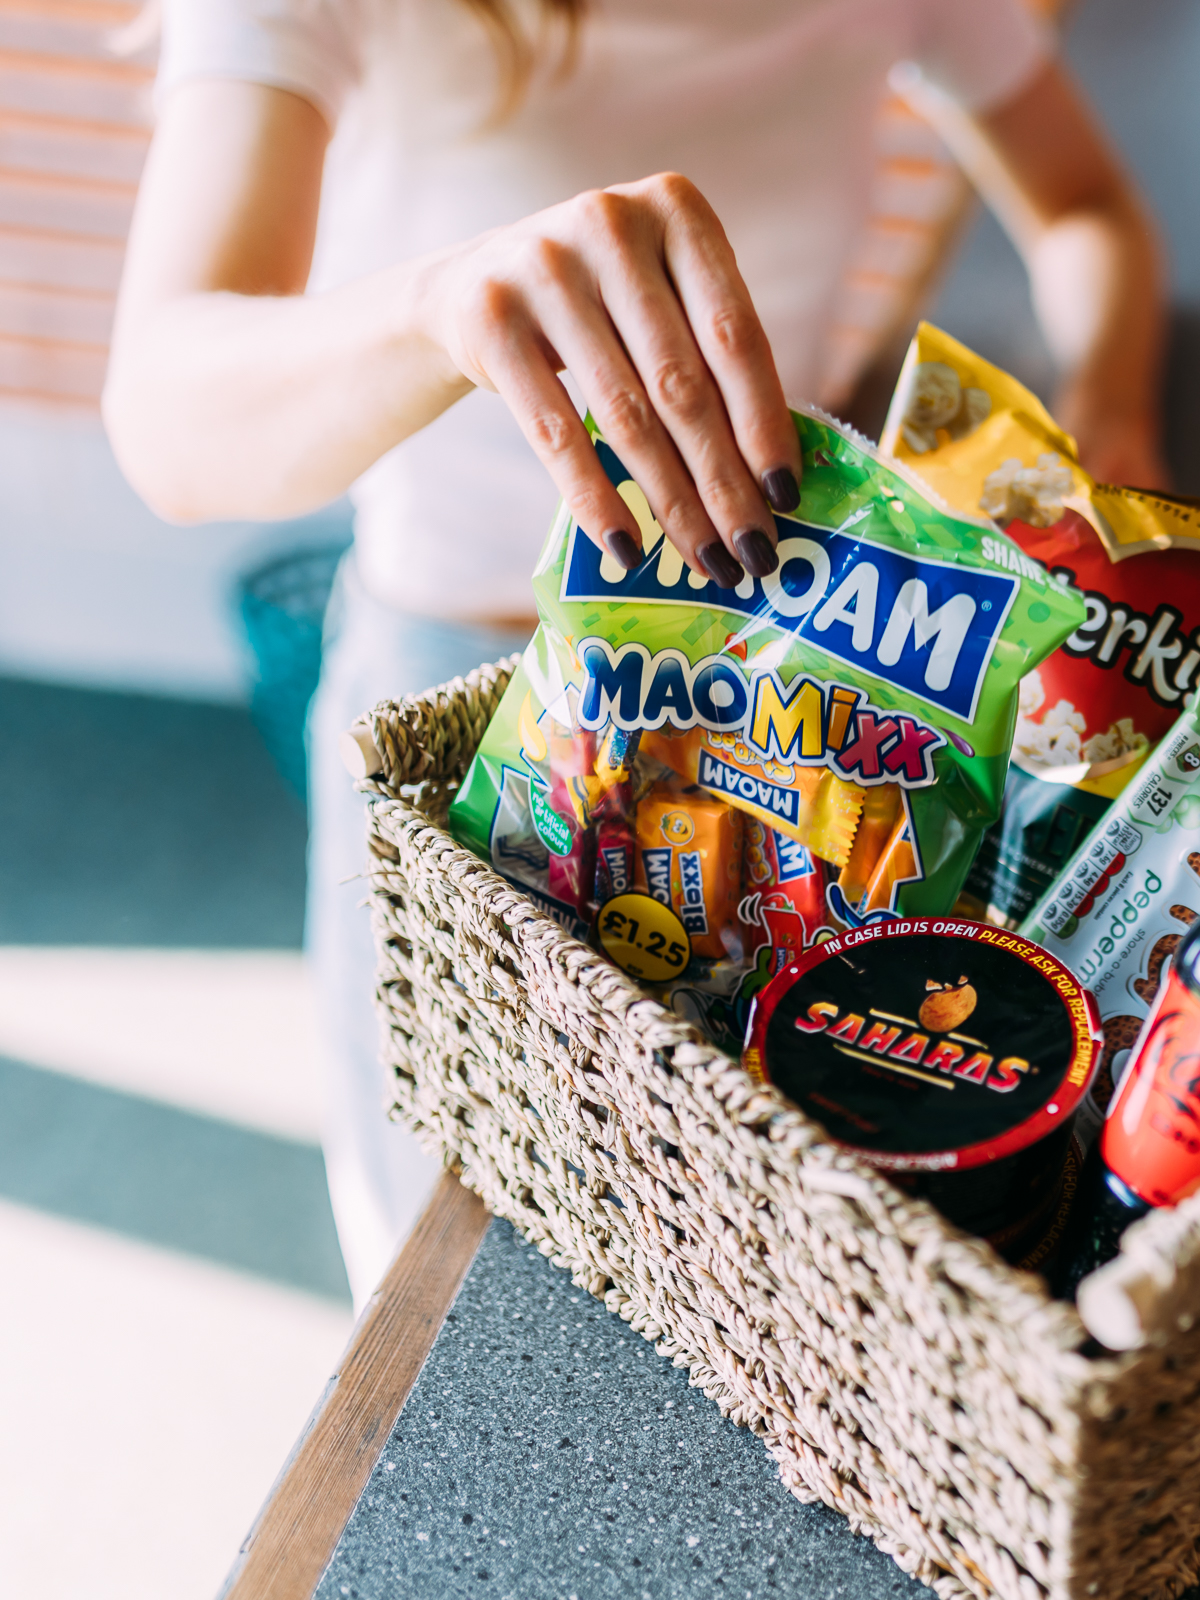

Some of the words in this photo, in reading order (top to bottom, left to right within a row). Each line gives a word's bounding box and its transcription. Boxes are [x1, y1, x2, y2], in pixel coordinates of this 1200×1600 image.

[599, 479, 979, 693] MOAM
[529, 790, 545, 808] no
[703, 759, 793, 816] MAOAM
[1131, 773, 1162, 809] CALORIES
[1145, 786, 1174, 817] 137
[532, 803, 573, 841] artificial
[536, 820, 571, 855] colours
[607, 851, 627, 894] MAO
[1098, 849, 1116, 867] 7.6g
[647, 852, 672, 904] OAM
[1082, 870, 1100, 887] 4.4g
[1105, 885, 1121, 903] pieces
[1120, 870, 1133, 885] Each
[1065, 889, 1085, 910] 15.2g
[1092, 901, 1110, 921] contain
[602, 910, 687, 967] £1.25
[1049, 910, 1070, 931] 0.05g
[1075, 868, 1164, 984] pepperm
[1090, 928, 1146, 998] share-a-bub
[824, 941, 842, 954] IN
[844, 927, 883, 947] CASE
[887, 922, 911, 936] LID
[913, 921, 928, 933] IS
[932, 922, 979, 938] OPEN
[978, 930, 1032, 958] PLEASE
[1028, 954, 1058, 977] ASK
[1051, 974, 1078, 998] FOR
[1066, 996, 1093, 1087] REPLACEMENT
[795, 1002, 1030, 1093] SAHARAS
[1017, 1202, 1071, 1270] REPLACEME
